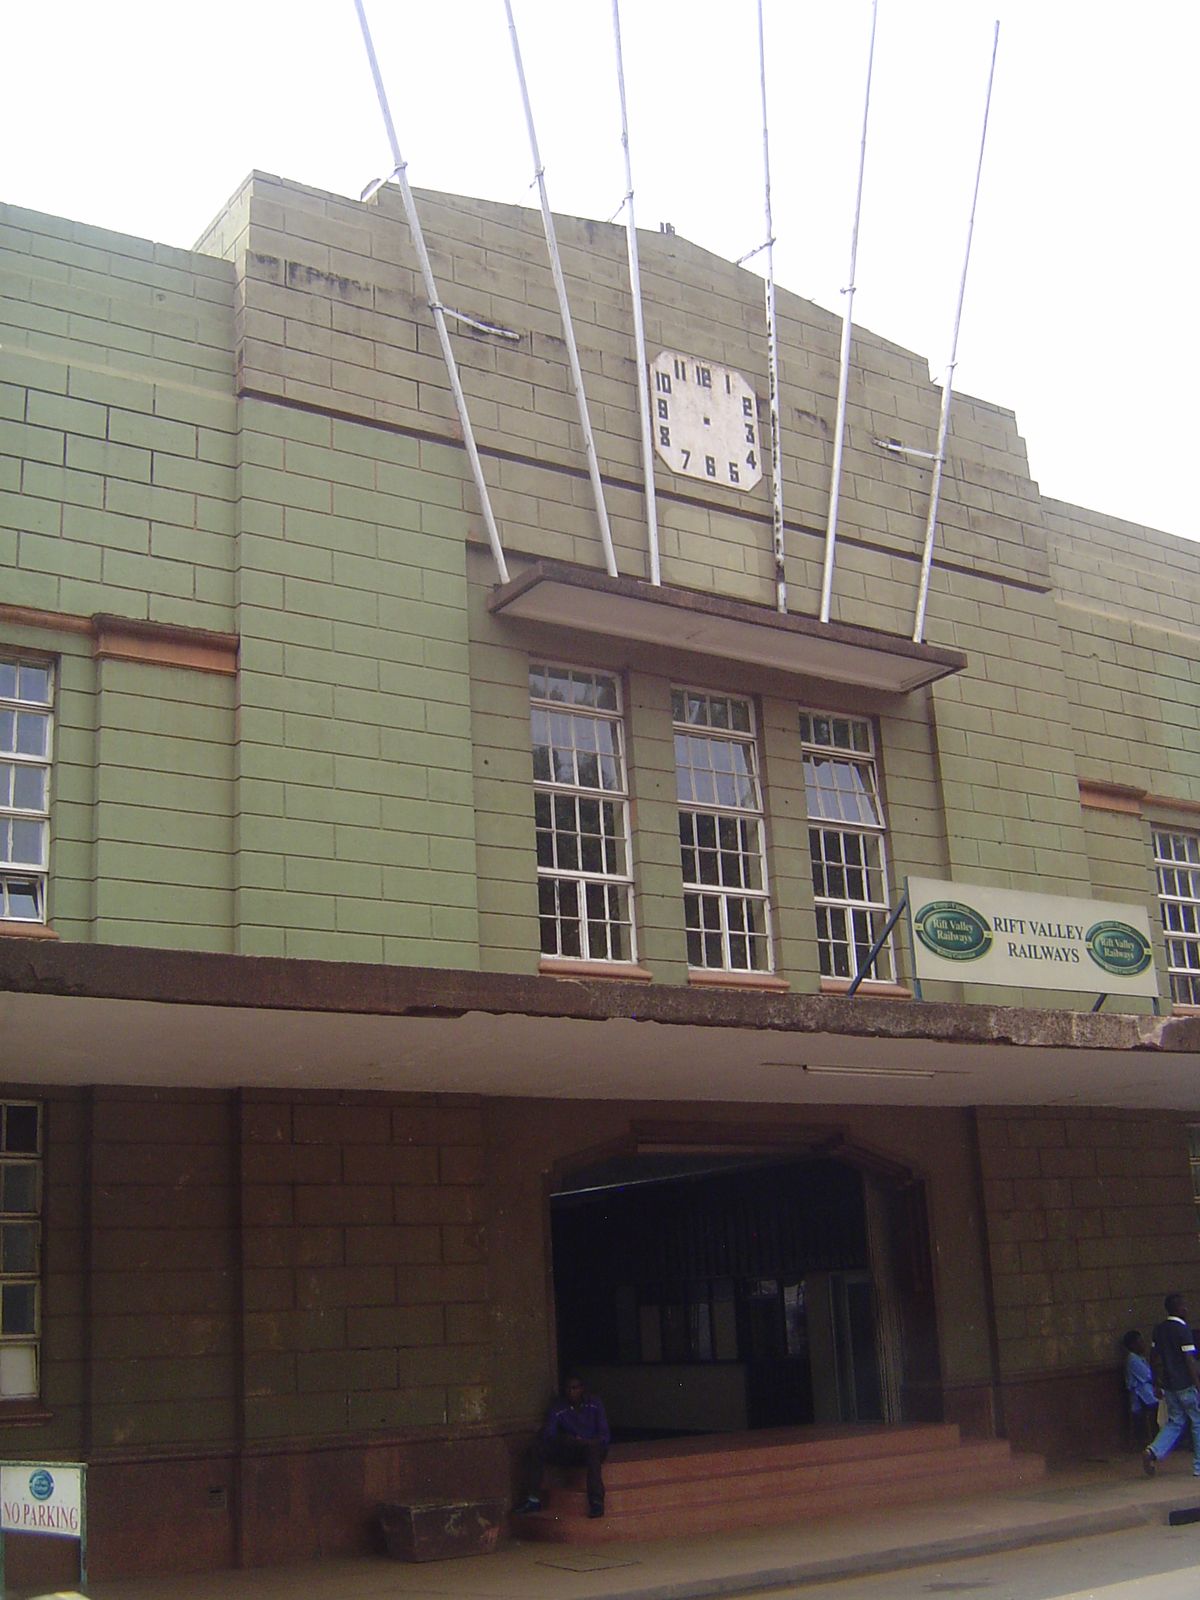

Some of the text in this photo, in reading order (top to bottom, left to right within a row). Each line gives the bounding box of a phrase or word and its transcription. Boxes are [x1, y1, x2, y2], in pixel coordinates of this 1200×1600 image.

[674, 359, 686, 381] 11
[696, 365, 712, 388] 12
[656, 371, 671, 394] 10
[725, 374, 730, 394] 1
[657, 398, 668, 420] 9
[742, 396, 753, 417] 2
[660, 426, 670, 447] 8
[745, 423, 755, 444] 3
[681, 449, 691, 470] 7
[705, 455, 716, 477] 6
[746, 450, 756, 470] 4
[729, 462, 739, 483] 5
[932, 919, 973, 934] Rift Valley
[937, 930, 973, 944] Railways
[993, 917, 1026, 934] RIFT
[1029, 921, 1084, 940] VALLEY
[1007, 942, 1080, 963] RAILWAYS
[4, 1502, 78, 1529] NO PARKING
